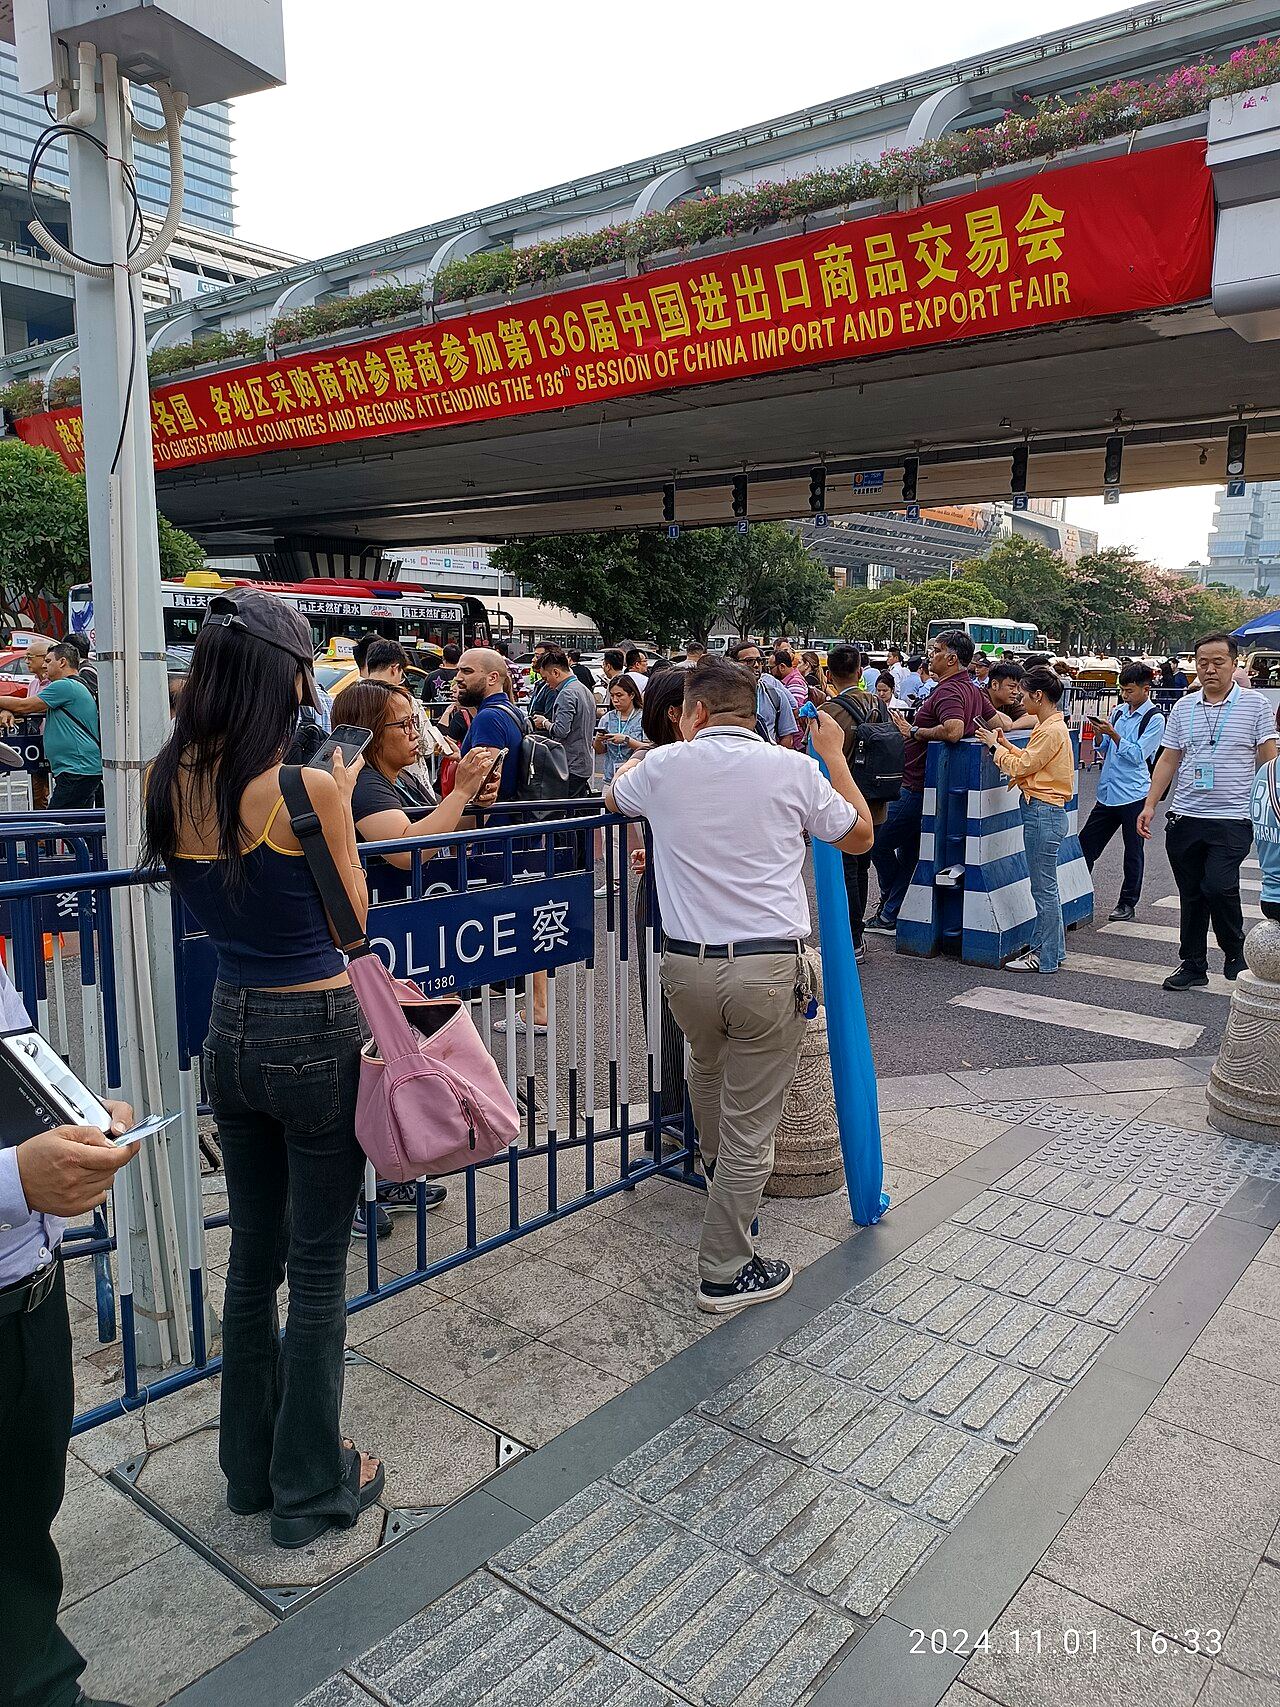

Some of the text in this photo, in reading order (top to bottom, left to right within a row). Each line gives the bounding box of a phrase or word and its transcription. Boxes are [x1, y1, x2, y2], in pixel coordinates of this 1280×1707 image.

[151, 193, 1066, 438] 各国、各地区采购商和参展商参加第136届中国进出口商品交易会
[154, 443, 171, 461] TO
[169, 435, 208, 459] GUESTS
[206, 428, 237, 452] FROM
[236, 424, 257, 448] ALL
[257, 413, 327, 444] COUNTRIES
[328, 406, 357, 432] AND
[357, 397, 415, 426] REGIONS
[416, 381, 502, 419] ATTENDING
[501, 378, 534, 402] THE
[575, 353, 652, 391] SESSION
[654, 349, 680, 378] OF
[683, 335, 749, 373] CHINA
[751, 316, 837, 361] IMPORT
[843, 306, 894, 344] AND
[901, 283, 1002, 334] EXPORT
[1008, 270, 1072, 313] FAIR
[1232, 483, 1241, 494] 7
[1108, 491, 1116, 502] 6
[1016, 498, 1025, 509] 5
[909, 507, 917, 517] 4
[818, 515, 826, 525] 3
[739, 522, 747, 532] 2
[174, 594, 216, 607] 真正天
[298, 600, 361, 615] 真正天然矿泉水
[403, 607, 456, 620] 真正天然矿泉水
[369, 900, 570, 977] OLICE 察
